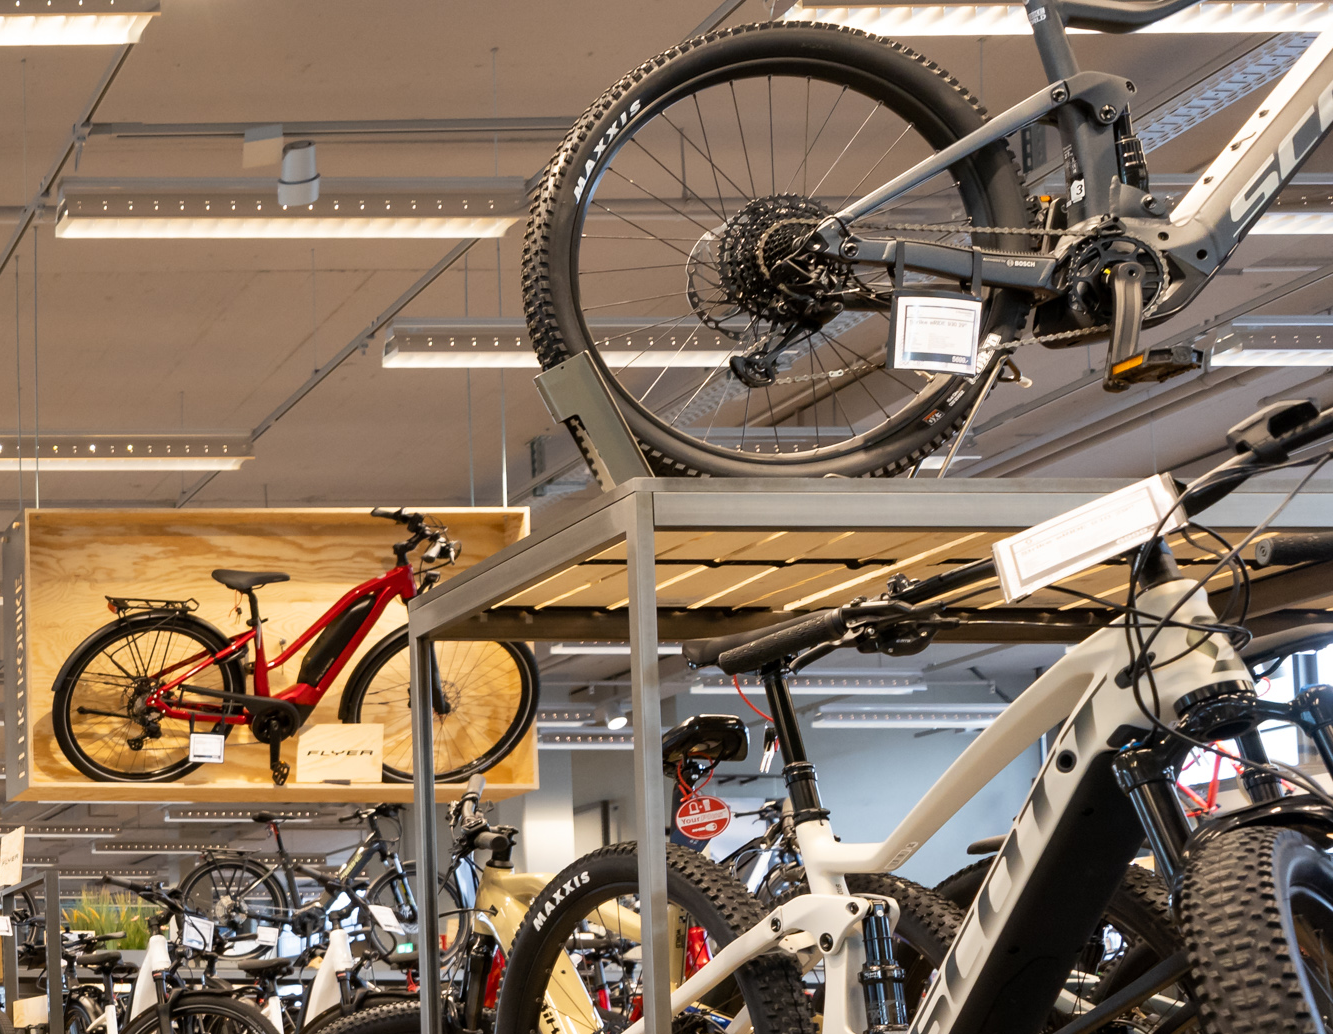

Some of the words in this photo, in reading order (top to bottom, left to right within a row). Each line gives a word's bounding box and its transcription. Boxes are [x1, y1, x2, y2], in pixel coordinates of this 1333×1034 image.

[573, 99, 641, 204] MAXXIS
[1076, 184, 1083, 195] 3
[1014, 260, 1036, 268] BOSCH
[307, 749, 374, 757] FLYER
[1, 853, 19, 867] FLYER
[533, 870, 591, 932] MAXXIS
